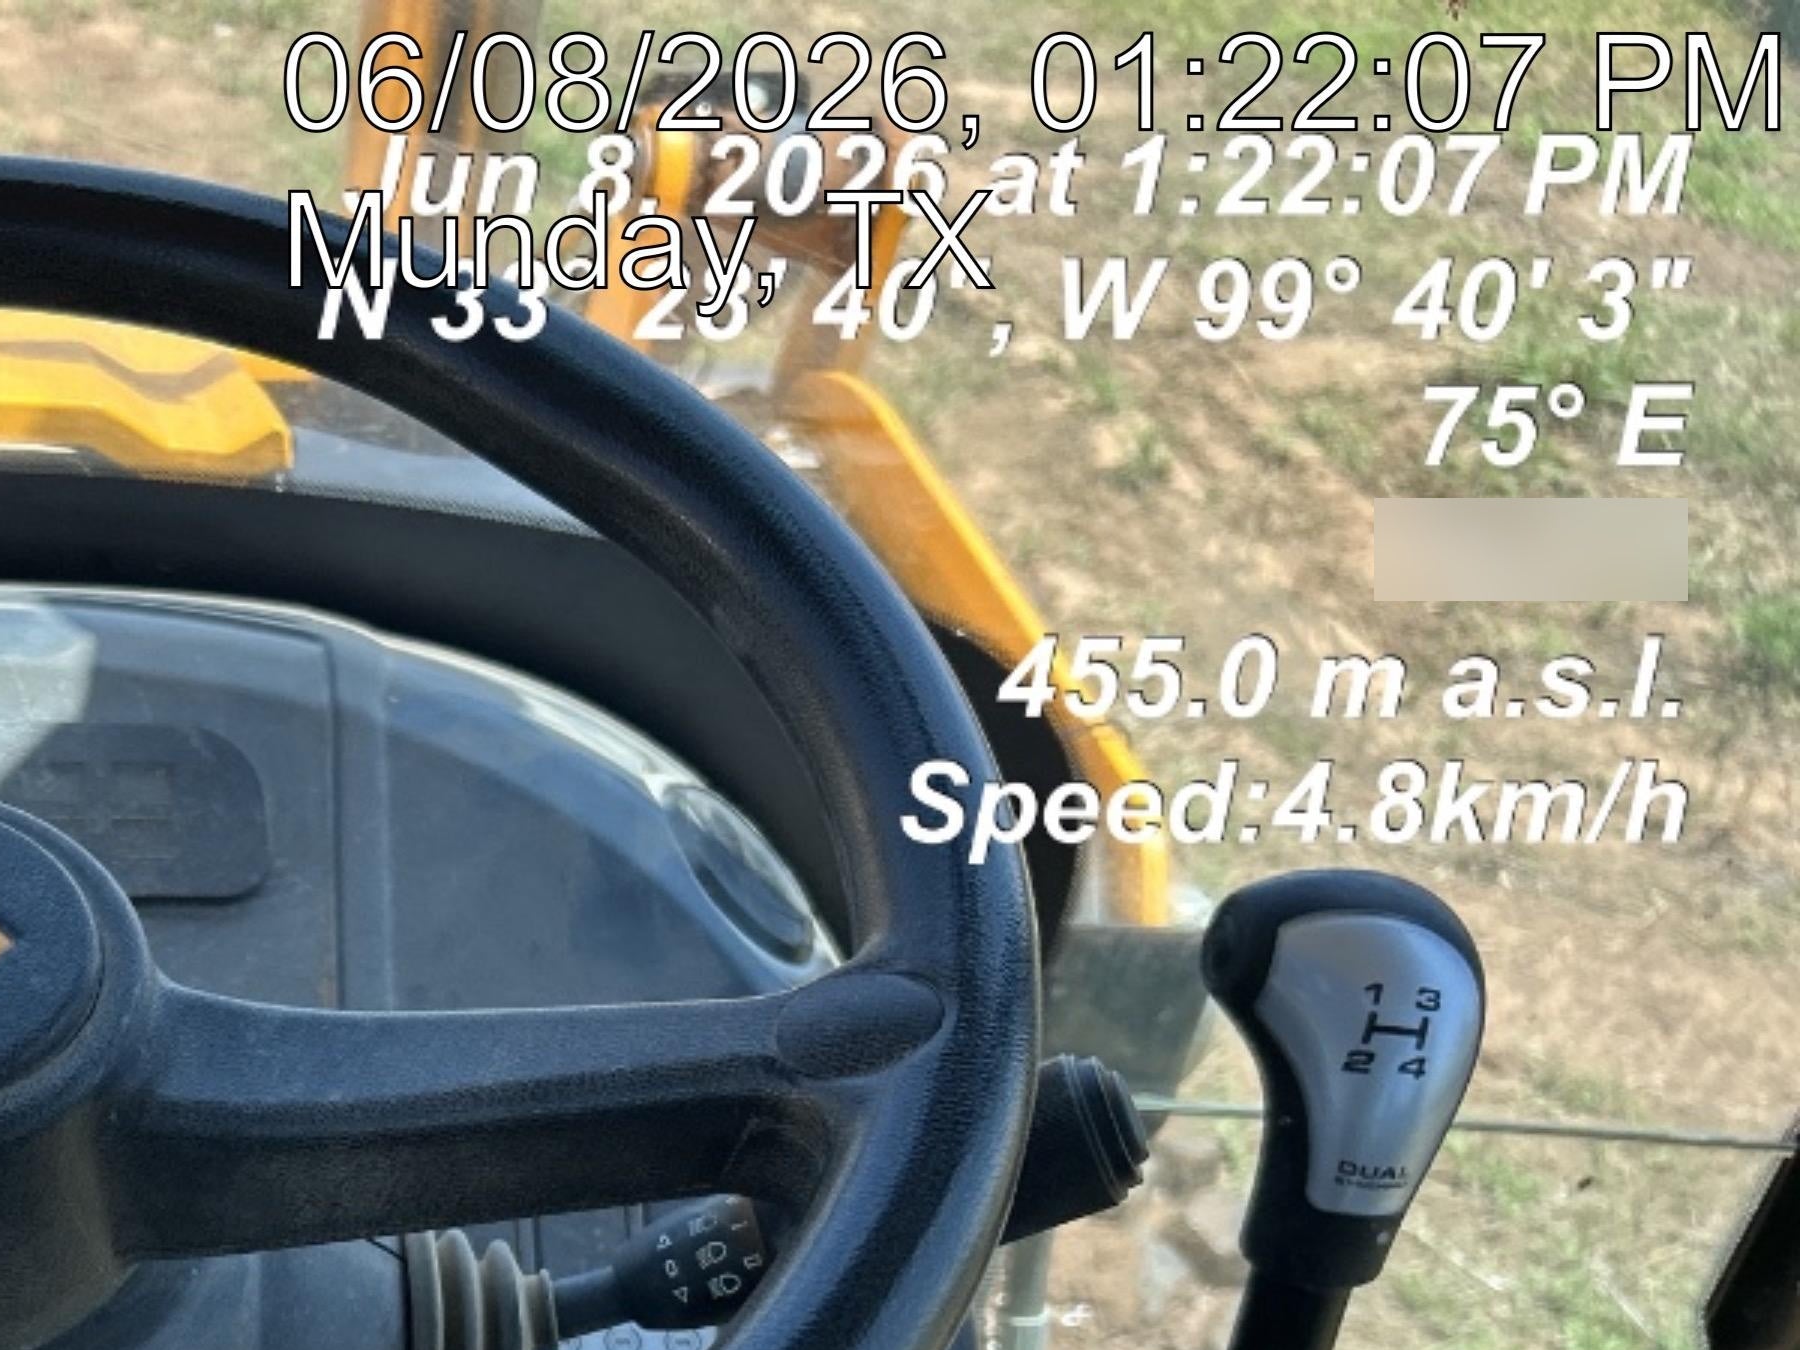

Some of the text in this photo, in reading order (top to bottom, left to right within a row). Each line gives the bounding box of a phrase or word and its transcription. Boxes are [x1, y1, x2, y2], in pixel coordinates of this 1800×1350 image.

[1364, 982, 1442, 1012] 1 3
[1341, 1050, 1427, 1081] 2 4
